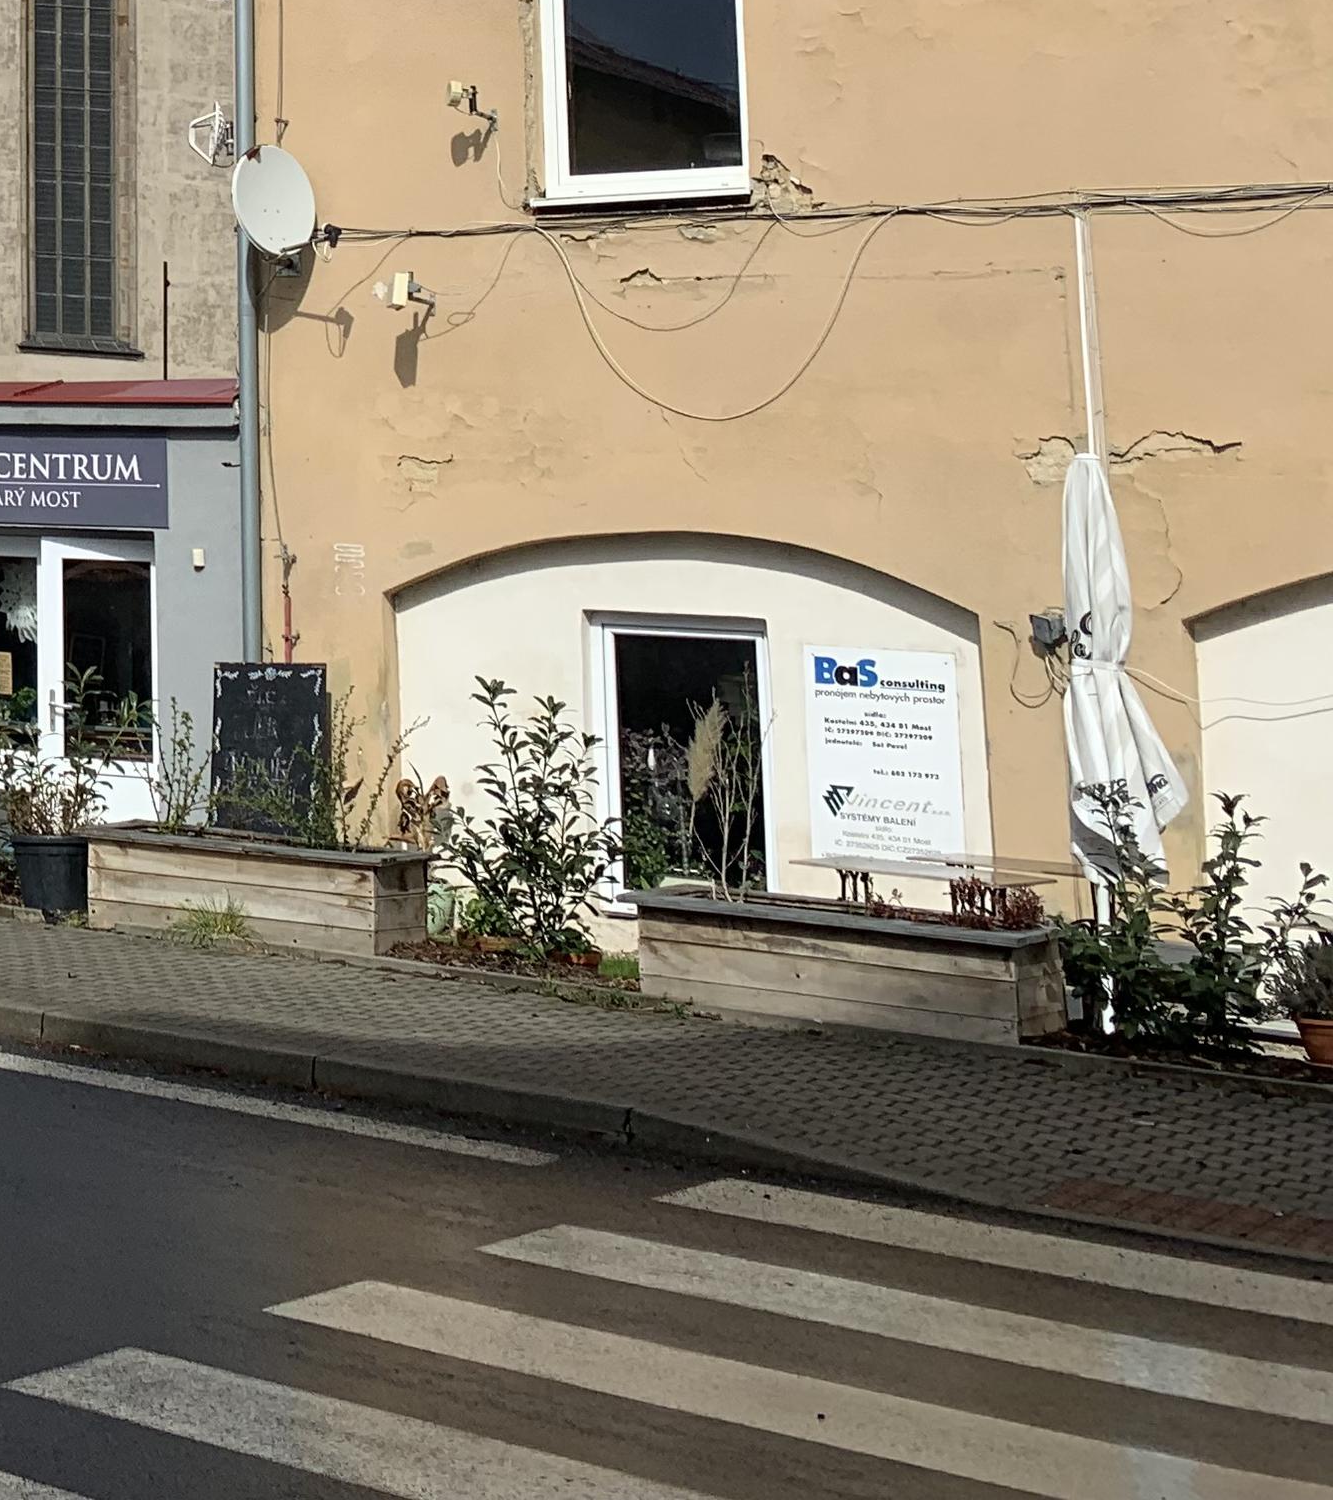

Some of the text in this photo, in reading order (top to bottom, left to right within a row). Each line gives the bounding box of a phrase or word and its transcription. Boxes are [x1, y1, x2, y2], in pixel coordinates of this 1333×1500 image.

[30, 490, 82, 508] MOST
[814, 656, 946, 693] BaS consulting
[815, 688, 946, 705] pronájem nebytových prostor
[911, 723, 932, 732] Most
[840, 812, 916, 827] SYSTÉMY BALENÍ
